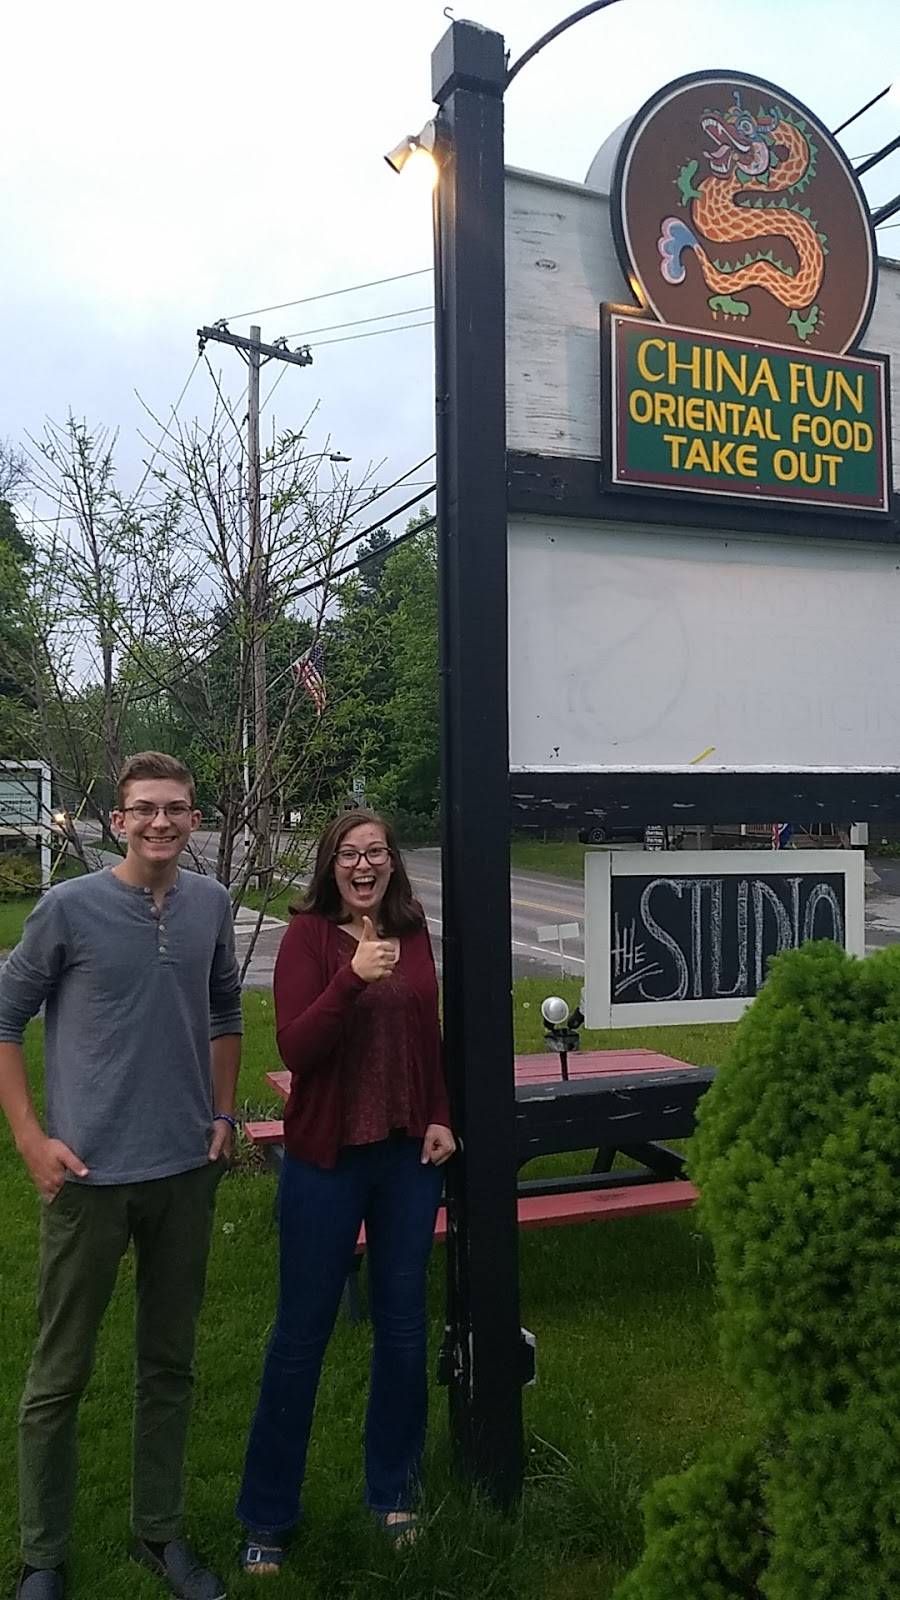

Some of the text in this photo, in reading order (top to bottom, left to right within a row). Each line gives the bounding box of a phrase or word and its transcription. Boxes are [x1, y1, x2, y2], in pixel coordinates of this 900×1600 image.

[637, 339, 863, 413] CHINA FUN
[629, 389, 873, 452] ORIENTAL FOOD
[663, 434, 843, 486] TAKE OUT
